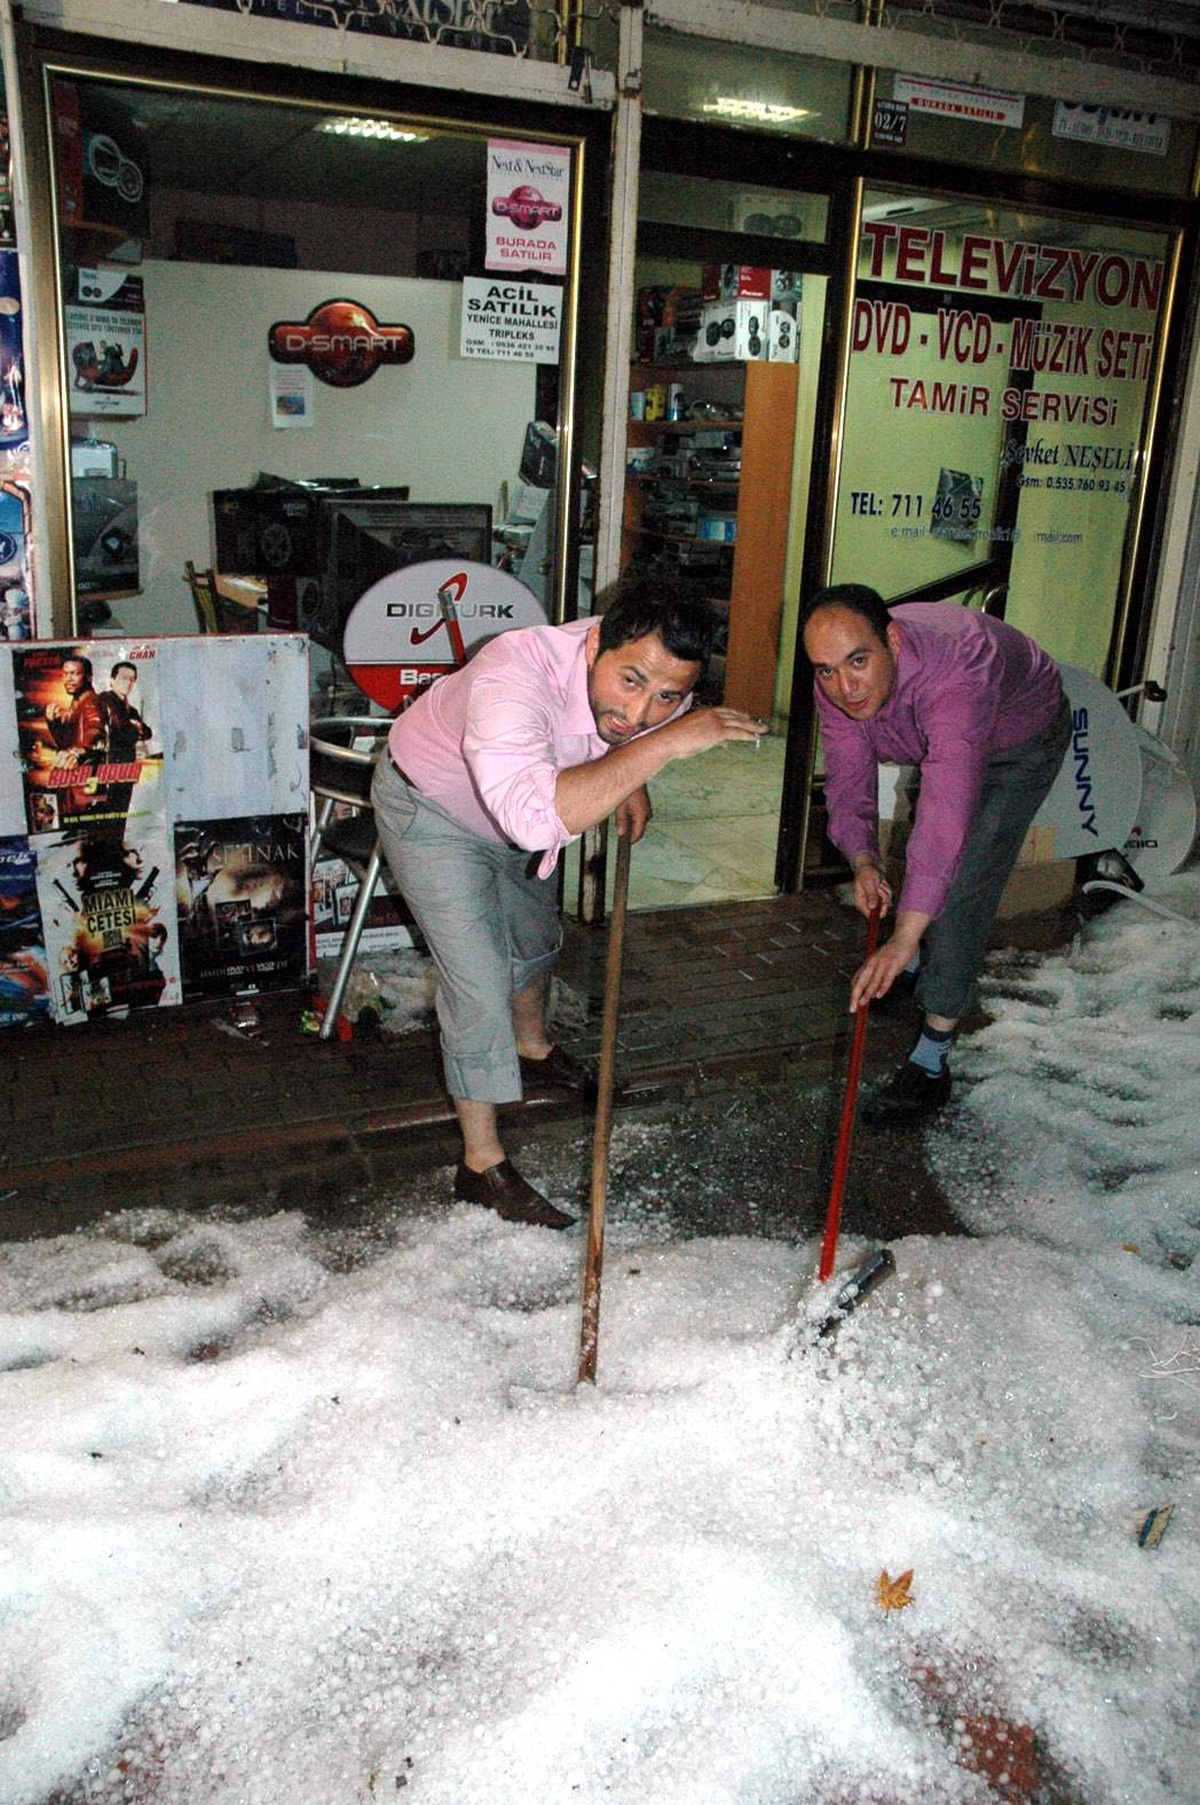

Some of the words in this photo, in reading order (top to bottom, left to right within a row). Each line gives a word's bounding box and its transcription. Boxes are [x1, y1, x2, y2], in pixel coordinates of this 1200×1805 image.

[875, 111, 906, 132] 02/7
[496, 202, 559, 216] D-SMART
[495, 236, 556, 249] BURADA
[500, 247, 552, 260] SATILIR
[487, 285, 538, 302] ACİL
[467, 299, 556, 317] SATILIK
[467, 313, 502, 325] YENİCE
[505, 317, 558, 329] MAHALLESİ
[852, 298, 912, 356] DVD
[937, 307, 992, 366] VCD
[285, 334, 403, 352] D-SMART
[851, 492, 883, 516] TEL:
[891, 494, 923, 518] 711
[932, 496, 953, 519] 46
[960, 498, 981, 519] 55
[128, 649, 156, 661] CHAN
[1072, 707, 1100, 838] SUNNY
[83, 776, 99, 795] 3
[83, 889, 134, 915] MIAMI
